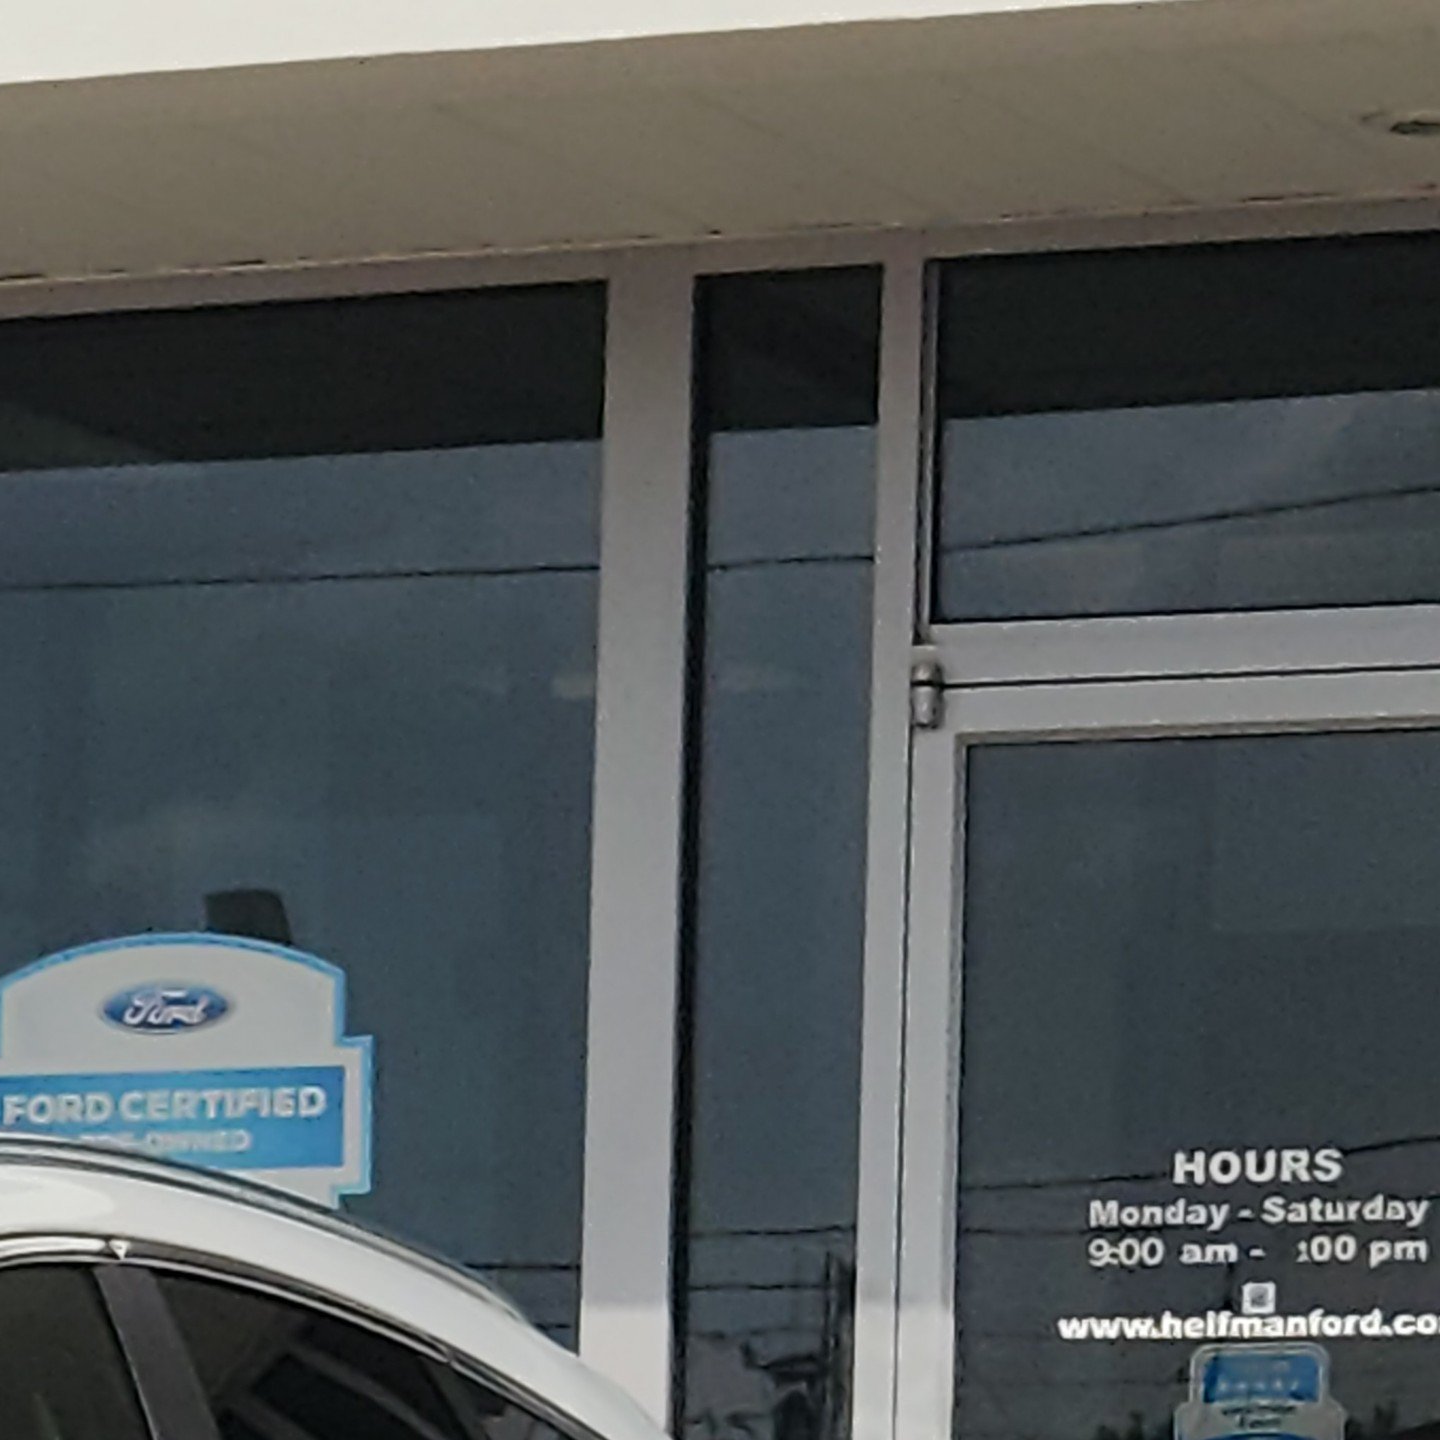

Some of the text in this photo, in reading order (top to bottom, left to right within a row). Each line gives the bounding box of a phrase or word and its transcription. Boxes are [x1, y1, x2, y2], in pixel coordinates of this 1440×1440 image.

[123, 989, 210, 1025] Ford
[2, 1086, 328, 1126] FORD CERTIFIED
[1172, 1148, 1344, 1185] HOURS
[1088, 1198, 1230, 1231] Monday
[1261, 1194, 1431, 1228] Saturday
[1087, 1236, 1165, 1267] 9:00
[1179, 1240, 1239, 1265] am
[1369, 1238, 1428, 1269] pm
[1057, 1307, 1440, 1341] www.helfmanford.co
